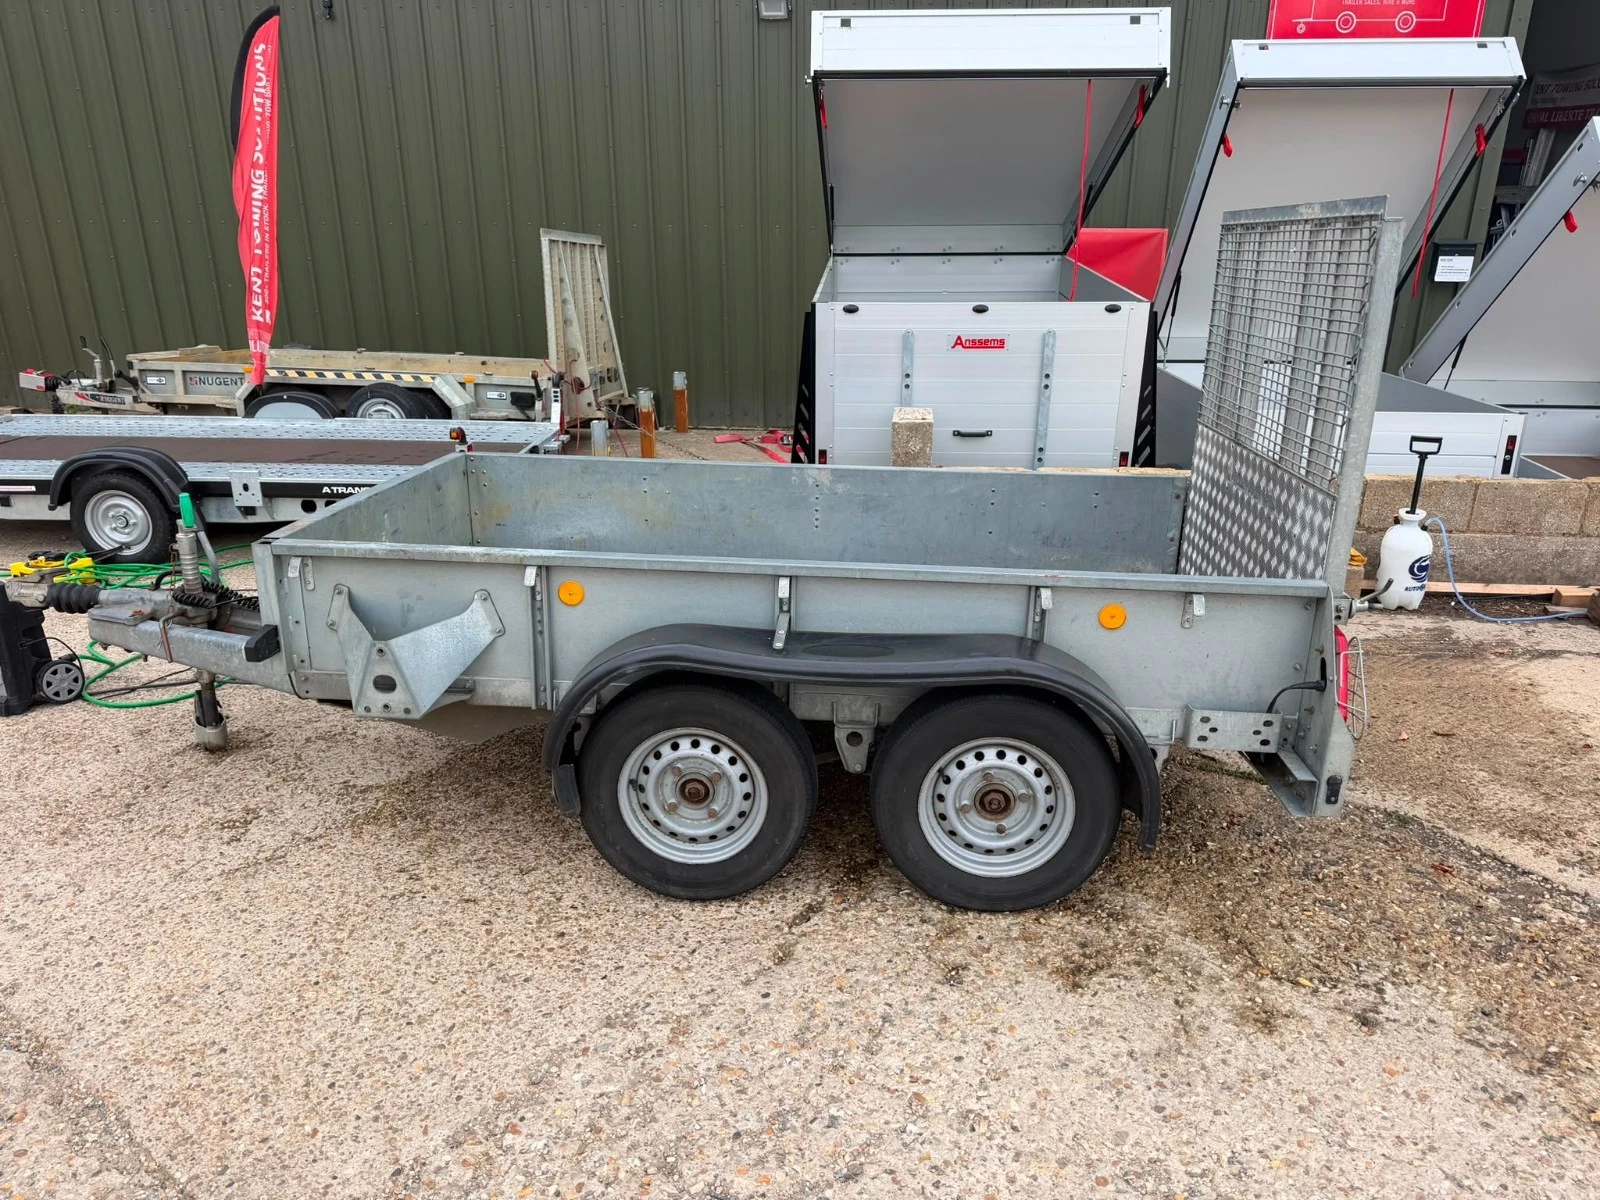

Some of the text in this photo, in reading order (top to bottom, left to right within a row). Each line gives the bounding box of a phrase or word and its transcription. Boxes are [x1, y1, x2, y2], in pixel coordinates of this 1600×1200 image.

[251, 267, 264, 322] KENT
[951, 335, 1005, 349] Anssems
[198, 376, 244, 386] NUGENT
